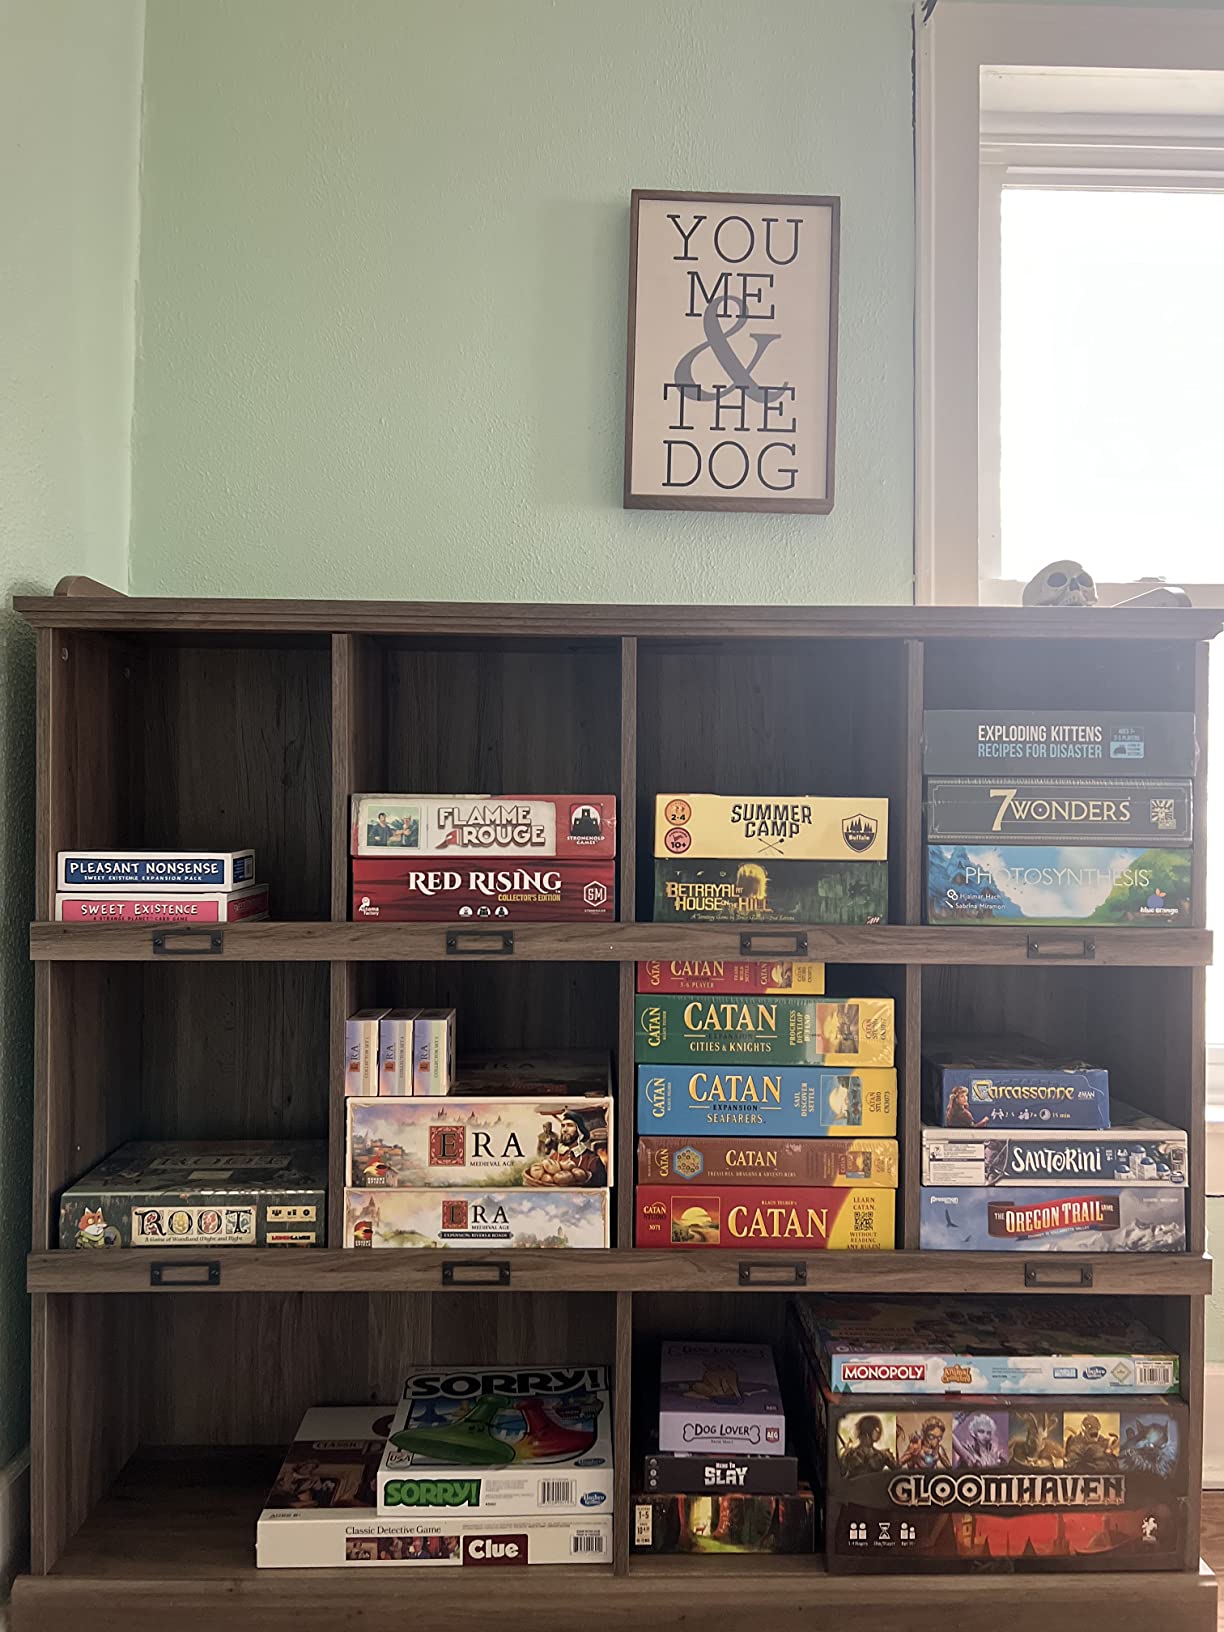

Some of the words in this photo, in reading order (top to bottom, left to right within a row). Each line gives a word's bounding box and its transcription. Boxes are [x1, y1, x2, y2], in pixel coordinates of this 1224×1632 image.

[666, 214, 804, 266] YOU
[685, 270, 775, 320] ME
[674, 294, 789, 404] &
[663, 382, 797, 433] THE
[661, 439, 799, 491] DOG
[978, 724, 1047, 742] EXPLODING
[1050, 726, 1102, 742] KITTENS
[978, 744, 1023, 758] RECIPES
[1026, 744, 1047, 758] FOR
[1050, 744, 1102, 759] DISASTER
[437, 804, 532, 828] FLAMME
[730, 803, 813, 826] SUMMER
[989, 788, 1018, 832] 7
[1010, 800, 1132, 822] WONDERS
[461, 824, 546, 848] ROUGE
[744, 820, 801, 839] CAMP
[70, 862, 140, 875] PLEASANT
[146, 862, 219, 875] NONSENSE
[964, 866, 1150, 888] PHOTOSYNTHESIS
[408, 871, 462, 896] RED
[468, 868, 562, 896] RISING
[665, 882, 740, 899] BETRAYAL
[498, 894, 536, 902] COLLECTOR'S
[537, 894, 561, 902] EDITION
[587, 888, 604, 900] SM
[674, 897, 722, 912] HOUSE
[738, 897, 774, 912] HILL
[80, 904, 125, 916] SWEET
[134, 903, 198, 916] EXISTENCE
[670, 960, 724, 976] CATAN
[648, 1007, 660, 1047] CATAN
[683, 1002, 778, 1033] CATAN
[690, 1042, 720, 1052] CITIES
[729, 1042, 772, 1053] KNIGHTS
[652, 1078, 666, 1118] CATAN
[688, 1072, 782, 1104] CATAN
[972, 1079, 1074, 1102] Carcassonne
[707, 1114, 764, 1124] SEAFARERS
[712, 1104, 758, 1112] EXPANSION
[438, 1132, 526, 1160] ERA
[659, 1149, 668, 1177] CATAN
[726, 1150, 778, 1167] CATAN
[450, 1204, 510, 1224] ERA
[644, 1204, 666, 1214] CATAN
[994, 1212, 1005, 1220] THE
[1005, 1206, 1060, 1233] OREGON
[1061, 1200, 1104, 1226] TRAIL
[134, 1208, 253, 1237] ROOT
[728, 1206, 828, 1239] CATAN
[412, 1369, 600, 1396] SORRY!
[844, 1365, 925, 1380] MONOPOLY
[694, 1424, 716, 1436] DOG
[719, 1424, 750, 1436] LOVER
[704, 1466, 748, 1486] SLAY
[386, 1479, 481, 1506] SORRY!
[888, 1474, 1126, 1507] GLOOMHAVEN
[638, 1511, 650, 1519] 1-5
[345, 1526, 375, 1535] Classic
[377, 1525, 414, 1535] Detective
[416, 1524, 442, 1534] Game
[468, 1539, 520, 1559] Clue
